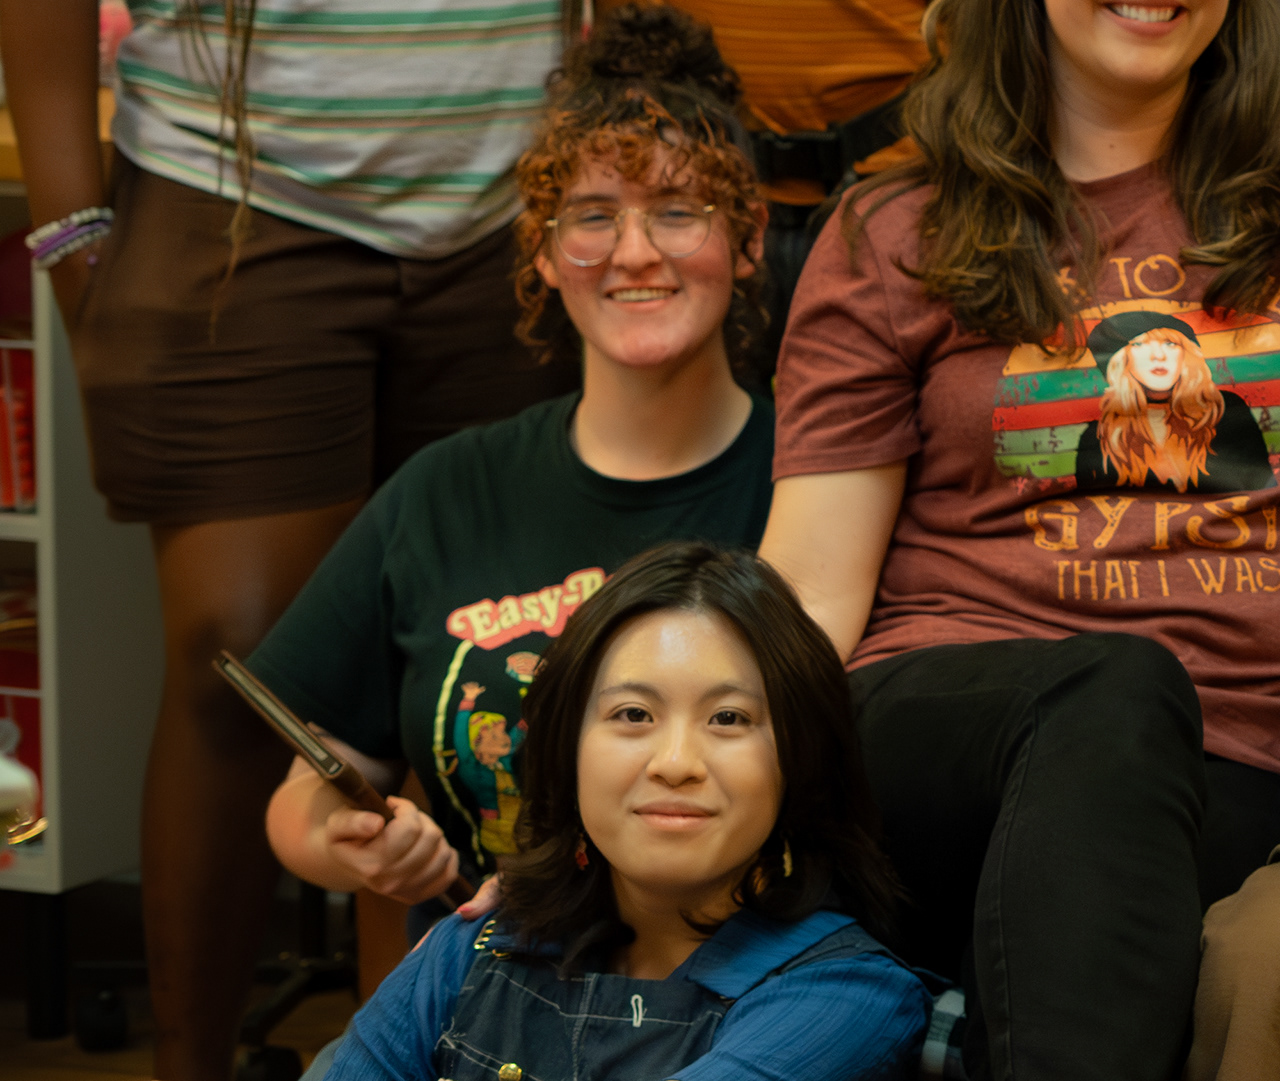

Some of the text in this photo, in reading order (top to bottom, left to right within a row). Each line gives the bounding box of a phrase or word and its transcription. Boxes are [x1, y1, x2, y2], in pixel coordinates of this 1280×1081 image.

[1109, 253, 1187, 299] TO
[1053, 559, 1141, 601] THAT
[1158, 559, 1171, 597] I
